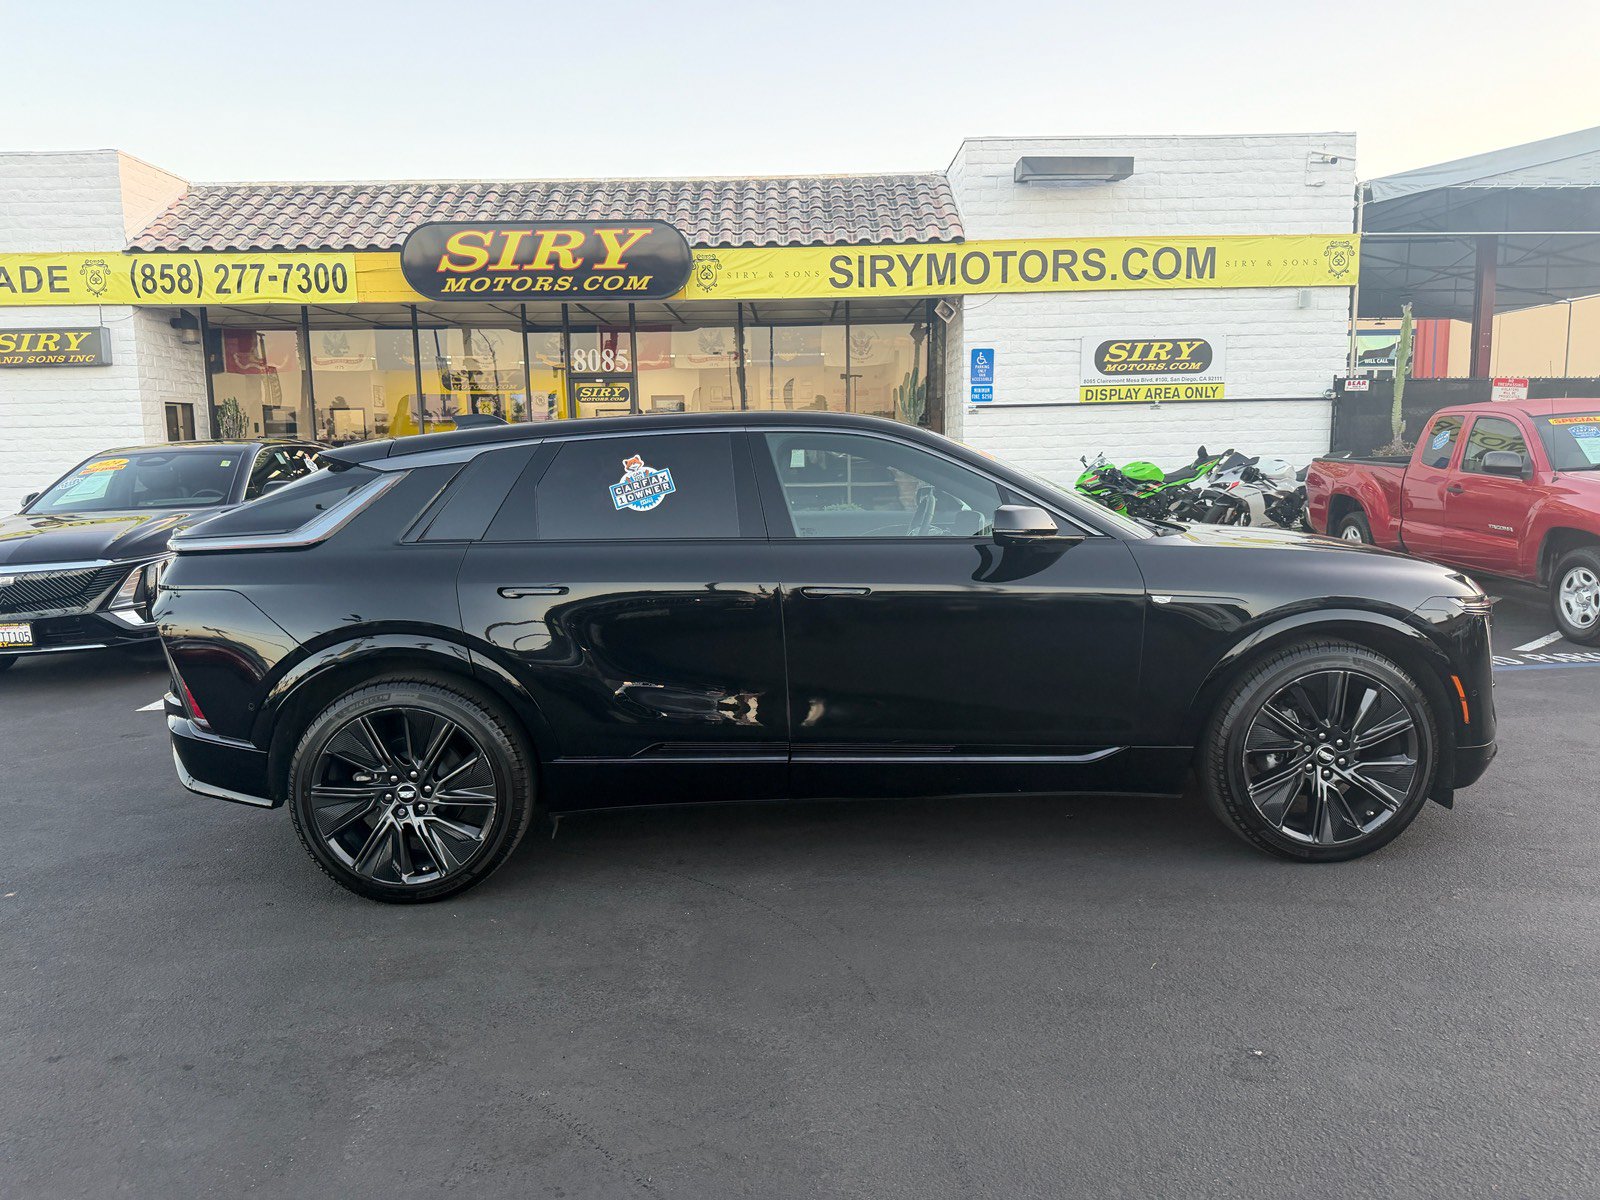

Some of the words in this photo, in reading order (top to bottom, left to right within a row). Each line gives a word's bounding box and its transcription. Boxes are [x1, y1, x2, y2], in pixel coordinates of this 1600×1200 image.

[437, 228, 653, 273] SIRY
[829, 247, 1216, 288] SIRYMOTORS.COM
[1224, 260, 1257, 269] SIRY
[1266, 259, 1273, 268] &
[1282, 258, 1320, 267] SONS
[130, 259, 204, 299] (858)
[214, 262, 348, 295] 277-7300
[441, 275, 653, 293] MOTORS.COM
[726, 271, 759, 280] SIRY
[768, 270, 775, 279] &
[783, 269, 821, 278] SONS
[0, 332, 91, 353] SIRY
[1103, 341, 1205, 362] SIRY
[26, 354, 67, 364] SONS
[68, 353, 96, 363] INC
[573, 348, 629, 372] 8085
[1104, 362, 1202, 372] MOTORS.COM
[580, 387, 626, 398] SIRY
[1085, 388, 1142, 401] DISPLAY
[1144, 388, 1181, 400] AREA
[1184, 386, 1219, 399] ONLY
[615, 475, 667, 494] CARFAX
[626, 483, 671, 502] OWNER
